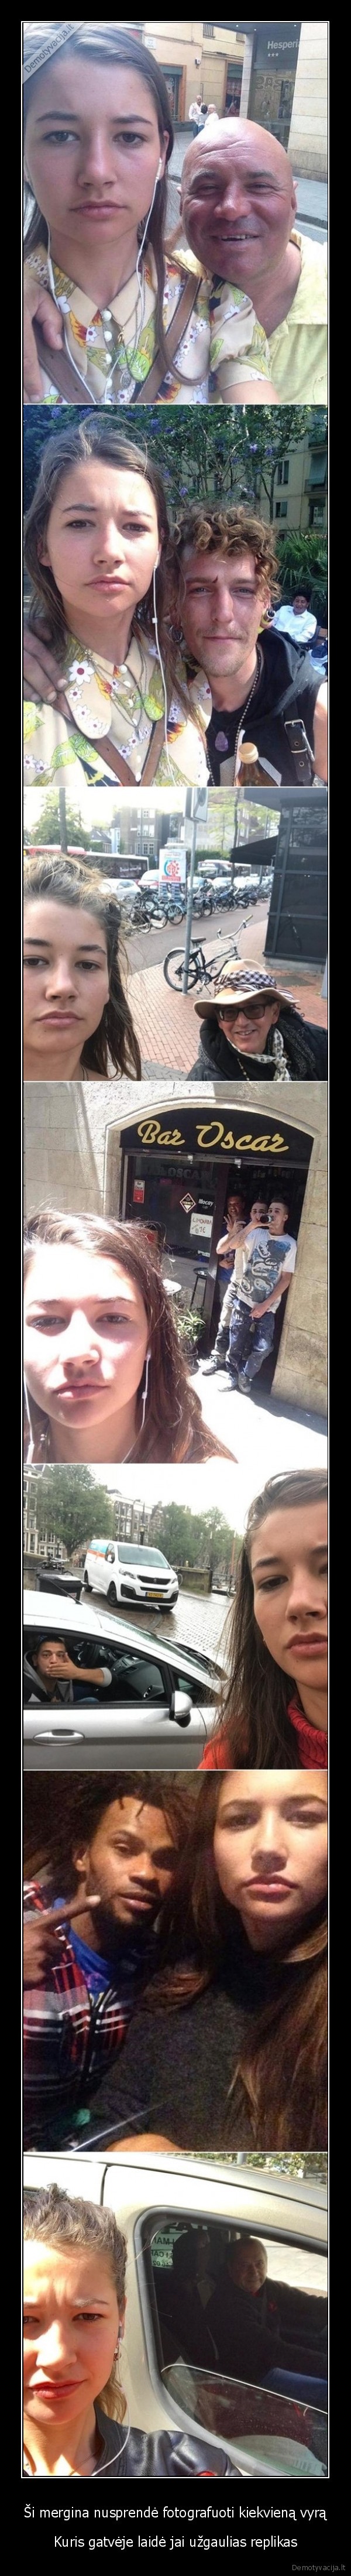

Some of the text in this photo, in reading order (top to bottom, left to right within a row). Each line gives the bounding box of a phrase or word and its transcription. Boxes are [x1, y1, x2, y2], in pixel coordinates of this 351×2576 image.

[137, 1120, 289, 1153] Bar Oscar
[198, 1198, 214, 1207] Mocay
